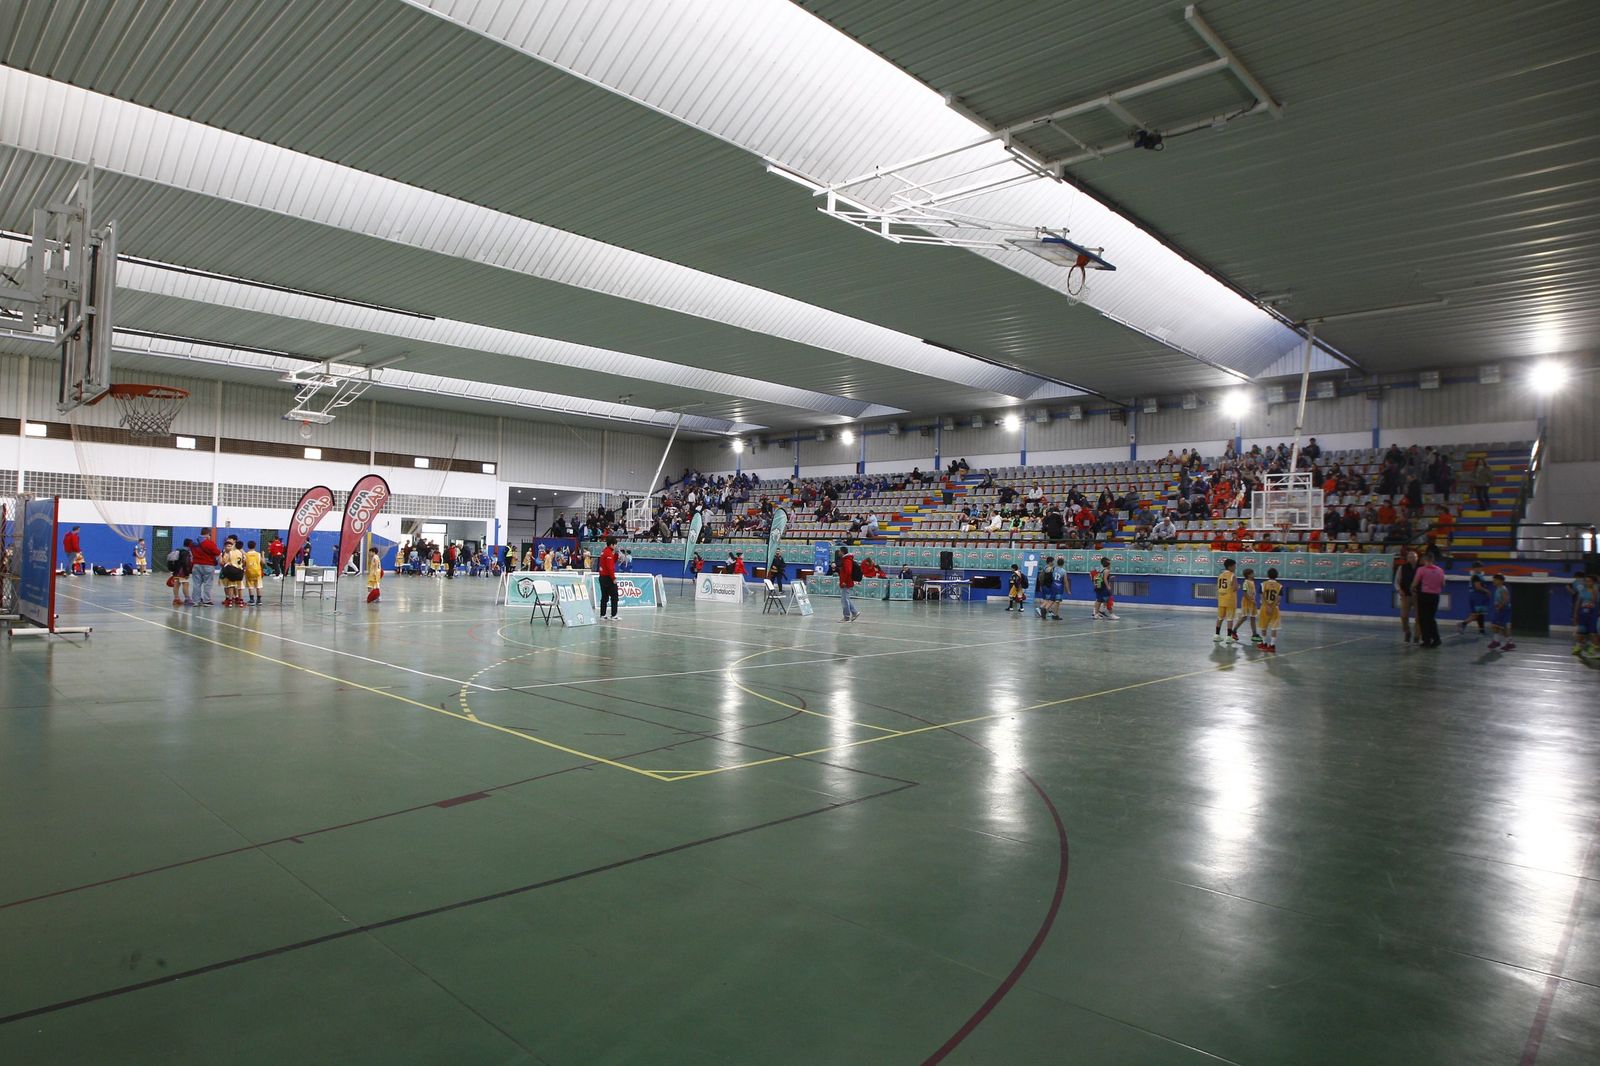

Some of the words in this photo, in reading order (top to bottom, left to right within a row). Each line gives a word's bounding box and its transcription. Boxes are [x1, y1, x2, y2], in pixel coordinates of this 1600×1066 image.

[297, 499, 316, 522] COPA
[349, 491, 369, 517] COPA
[352, 485, 385, 532] COVAP
[298, 496, 331, 536] COVAP
[617, 587, 642, 597] OVAP
[1218, 578, 1228, 589] 15
[1265, 589, 1277, 601] 16
